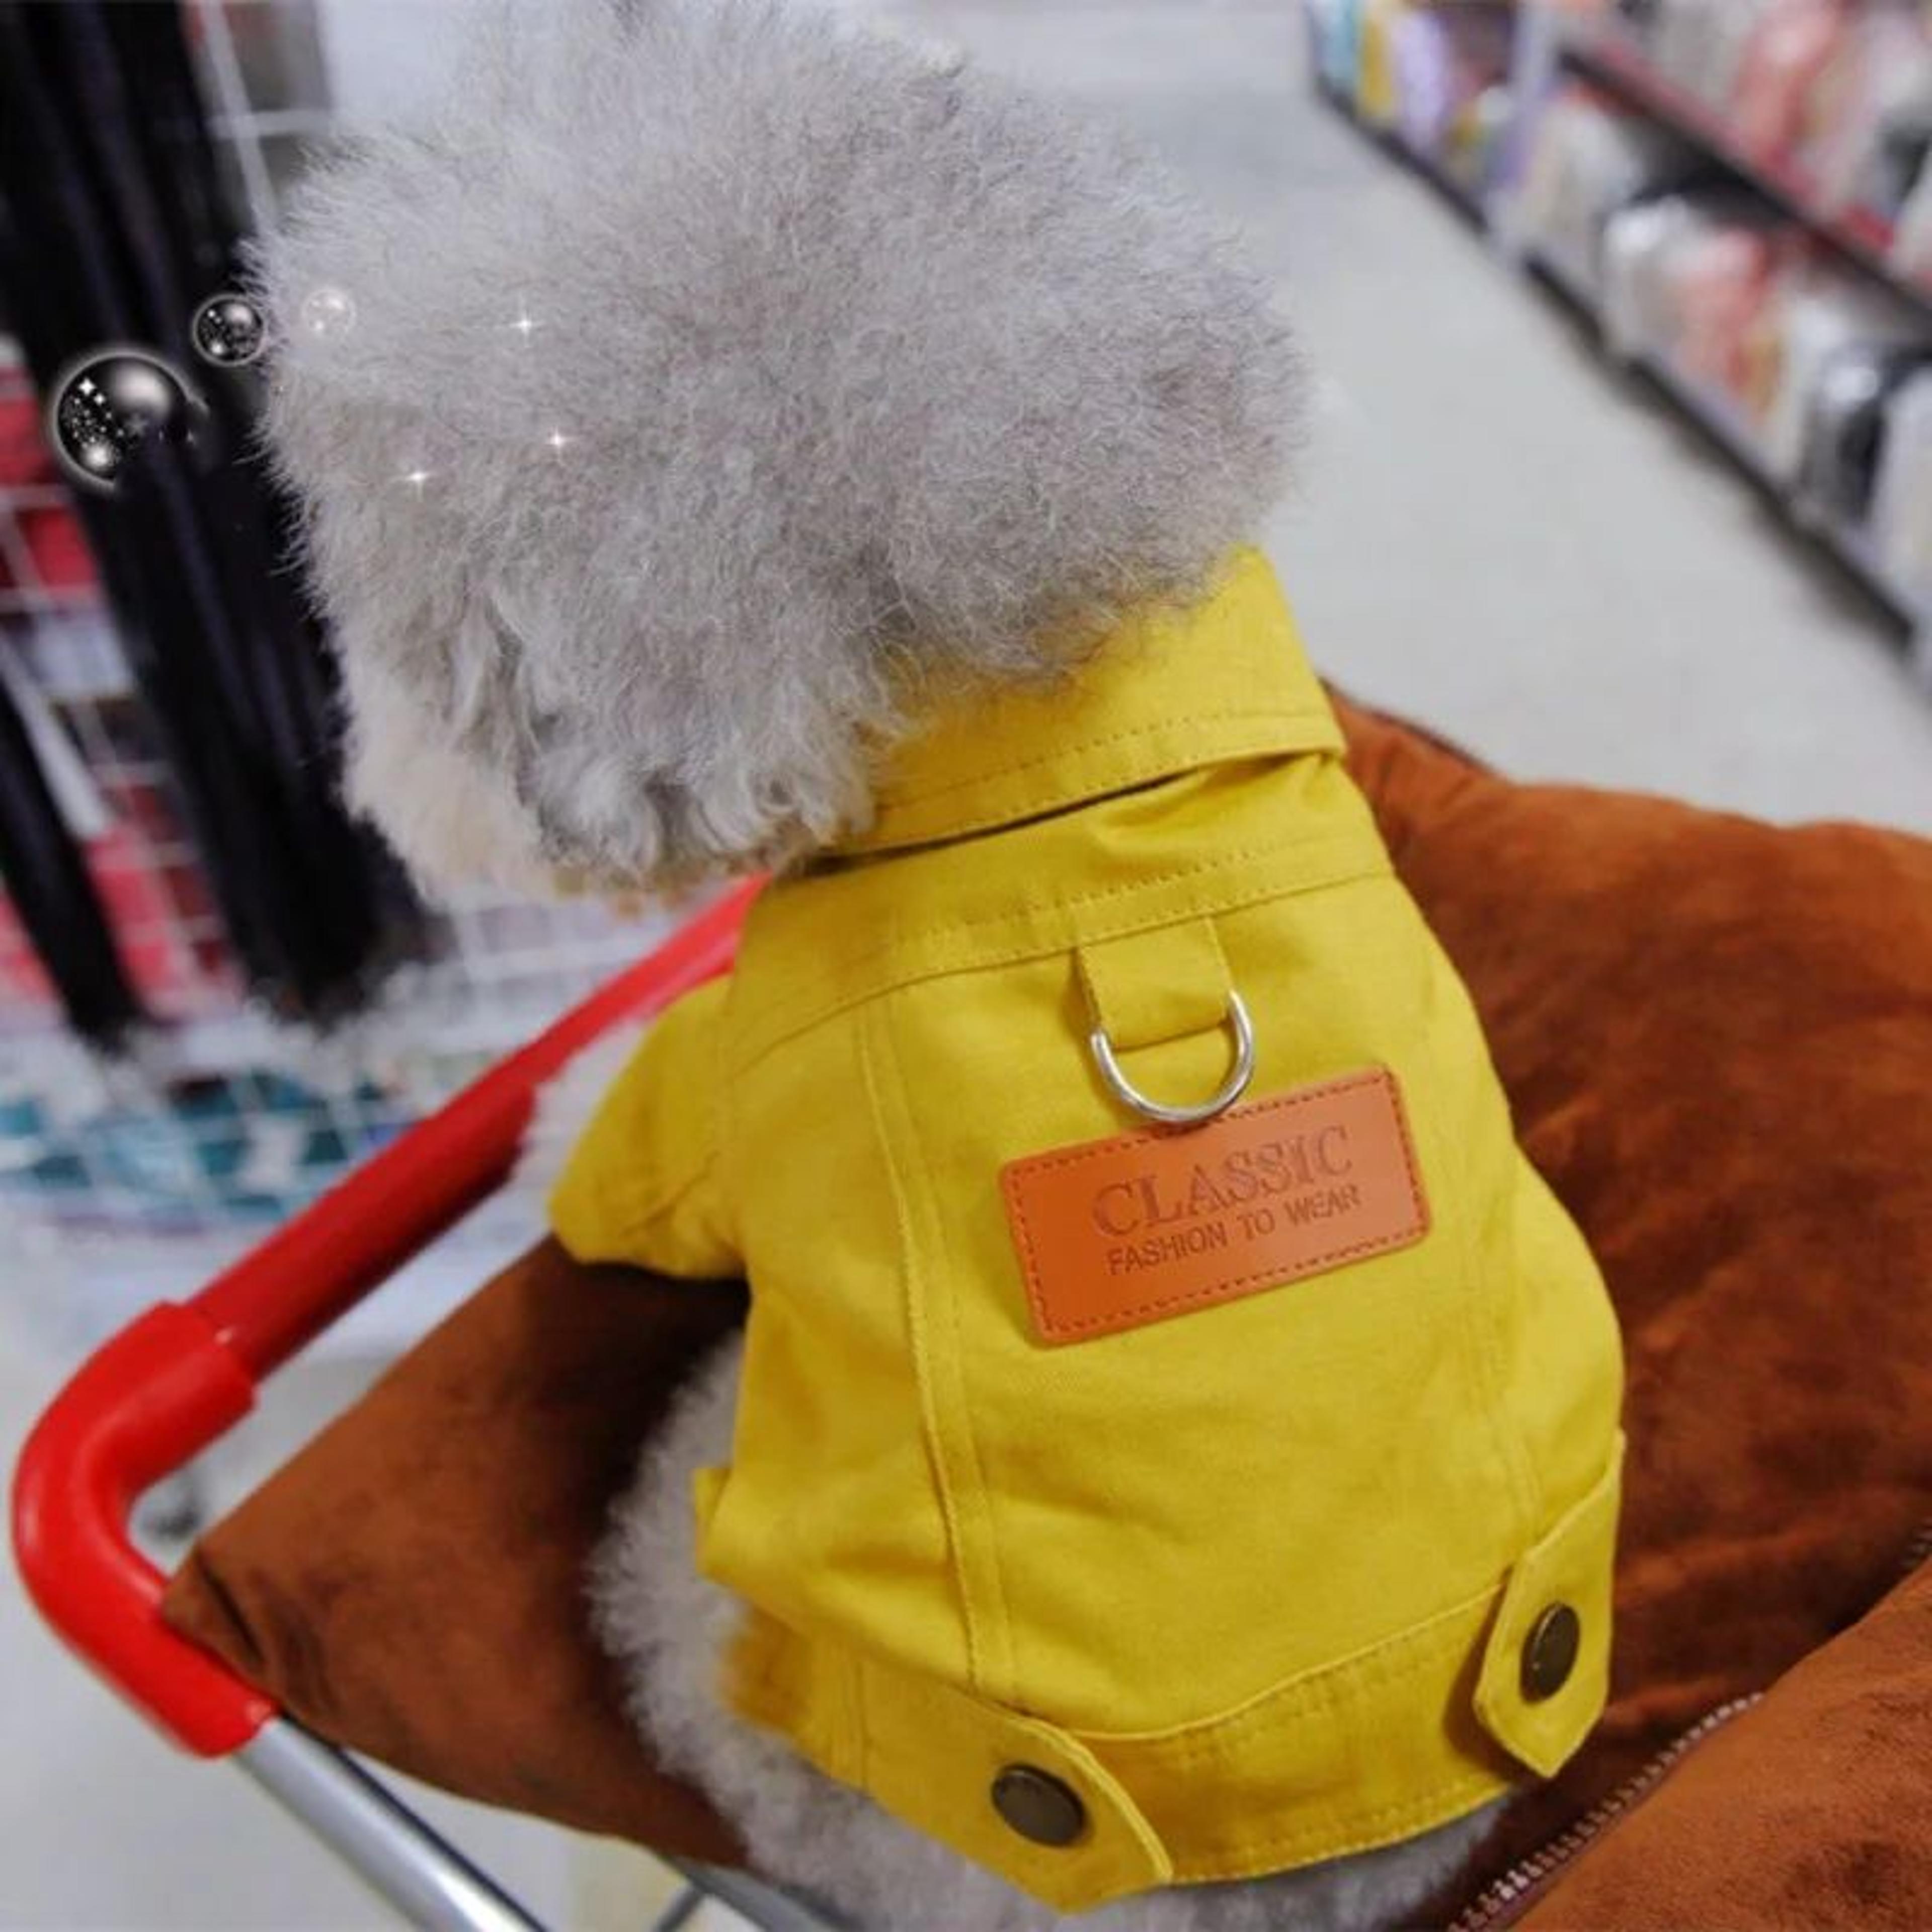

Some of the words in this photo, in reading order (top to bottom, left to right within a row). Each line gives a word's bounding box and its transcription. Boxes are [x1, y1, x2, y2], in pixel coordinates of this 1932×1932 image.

[1091, 1124, 1354, 1237] CLASSIC
[1109, 1222, 1229, 1276] FASHION
[1236, 1209, 1275, 1243] TO
[1284, 1184, 1361, 1227] WEAR
